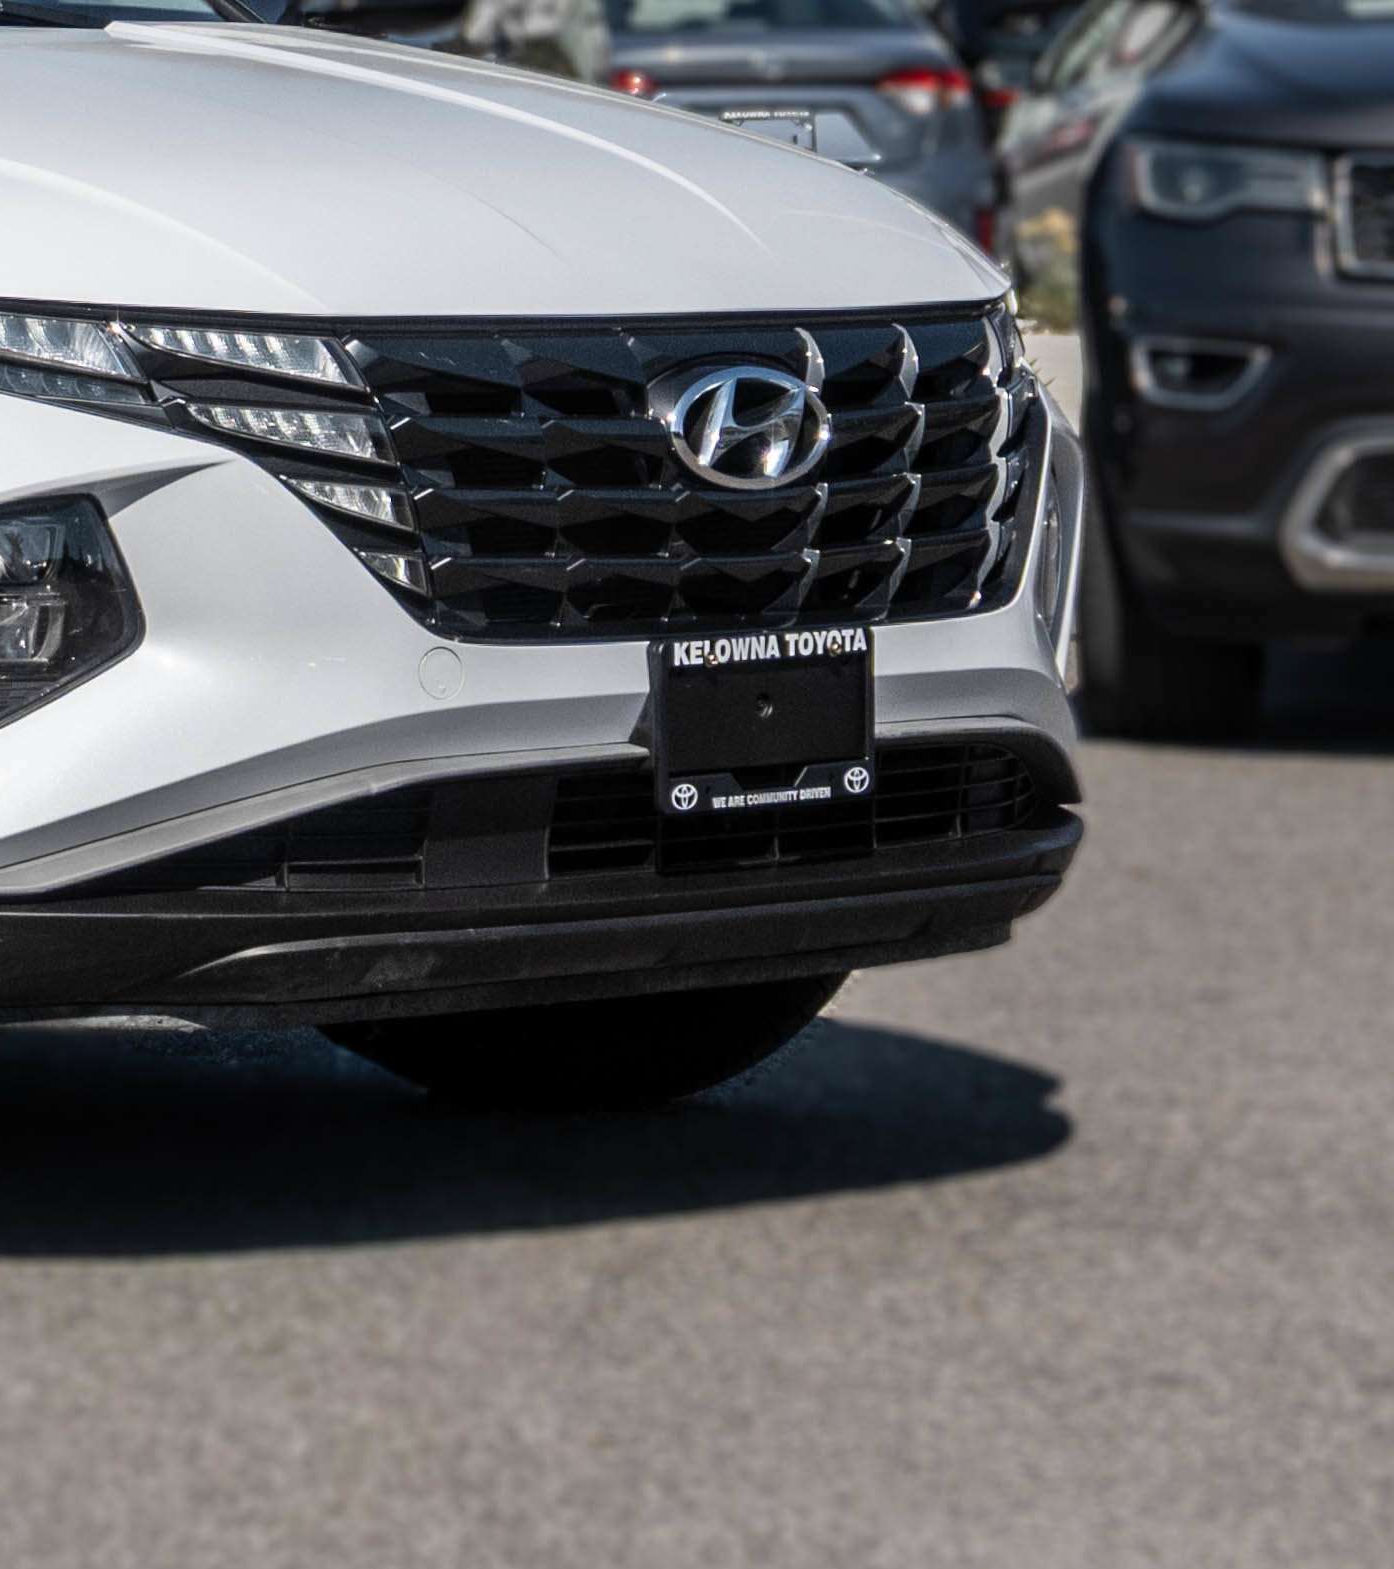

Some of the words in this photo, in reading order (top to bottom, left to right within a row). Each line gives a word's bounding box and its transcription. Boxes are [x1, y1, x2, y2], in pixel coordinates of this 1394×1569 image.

[673, 635, 781, 666] KELOWNA
[784, 628, 868, 657] TOYOTA
[712, 796, 727, 809] WE
[728, 795, 746, 808] ARE
[746, 790, 799, 805] COMMUNITY
[799, 786, 831, 801] DRIVEN
